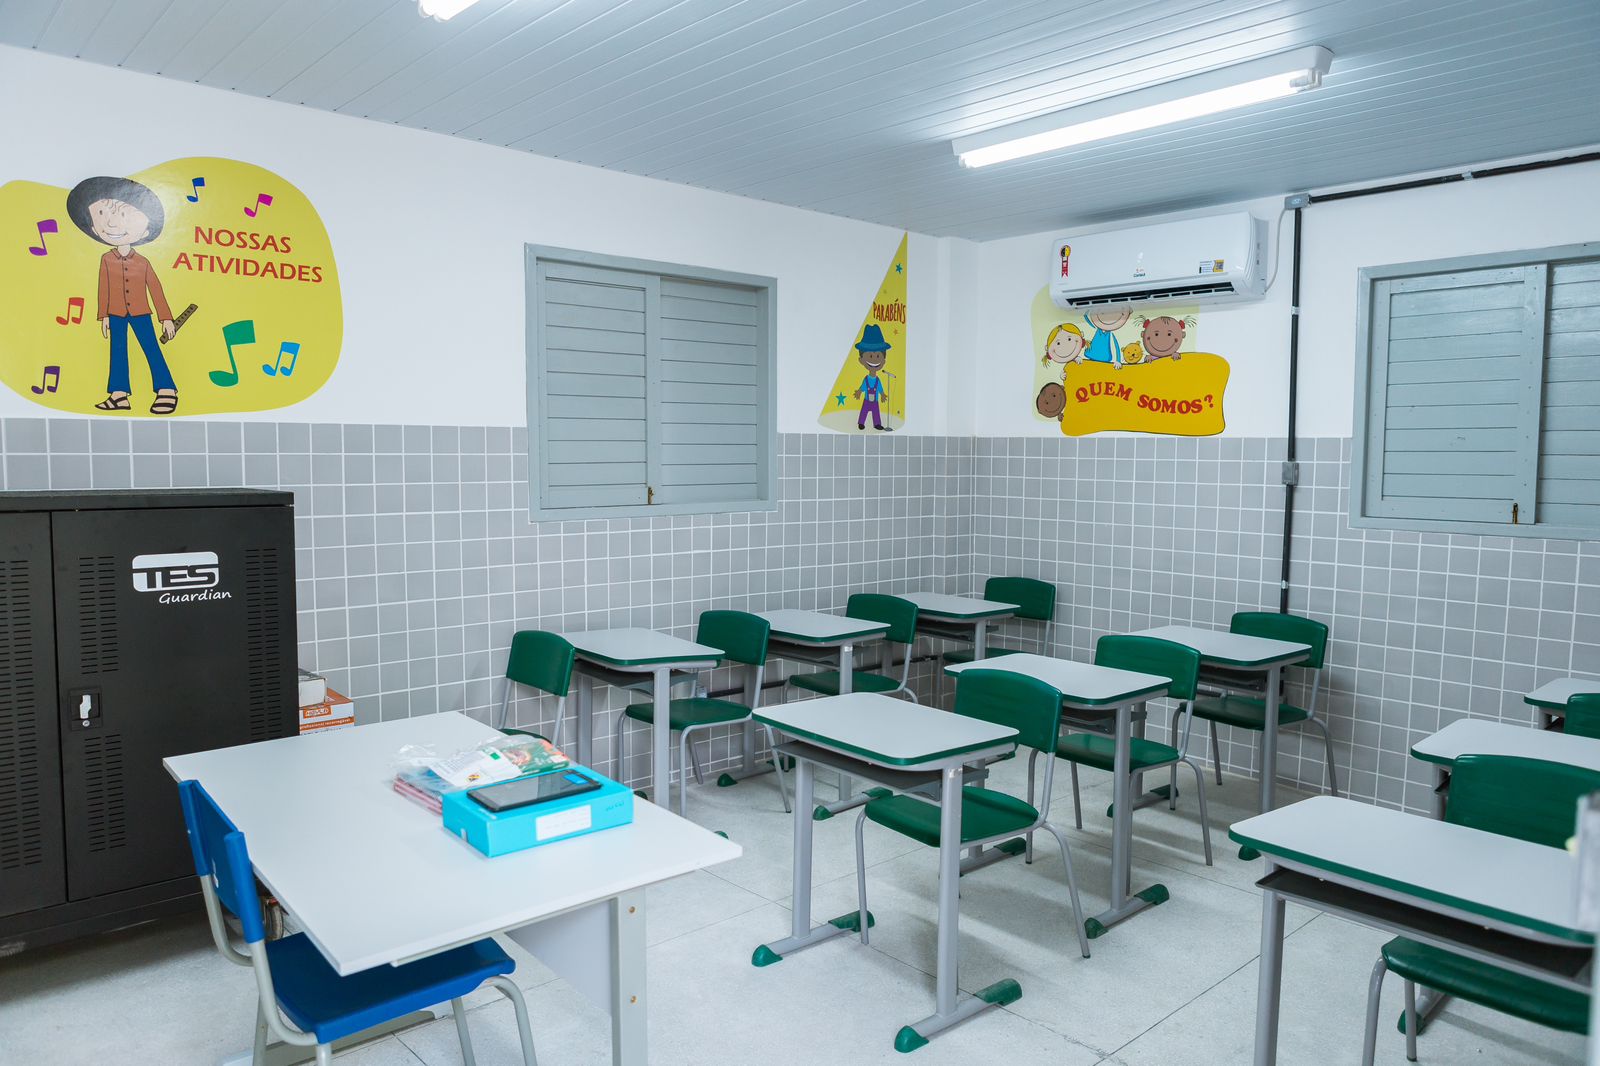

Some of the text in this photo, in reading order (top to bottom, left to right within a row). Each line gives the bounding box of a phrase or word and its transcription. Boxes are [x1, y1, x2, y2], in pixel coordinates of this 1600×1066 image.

[194, 226, 292, 254] NOSSAS
[172, 252, 323, 283] ATIVIDADES
[873, 298, 906, 324] PARABÉNS
[1075, 382, 1214, 414] QUEM SOMOS?
[132, 562, 219, 591] TES
[158, 589, 232, 605] Guardian
